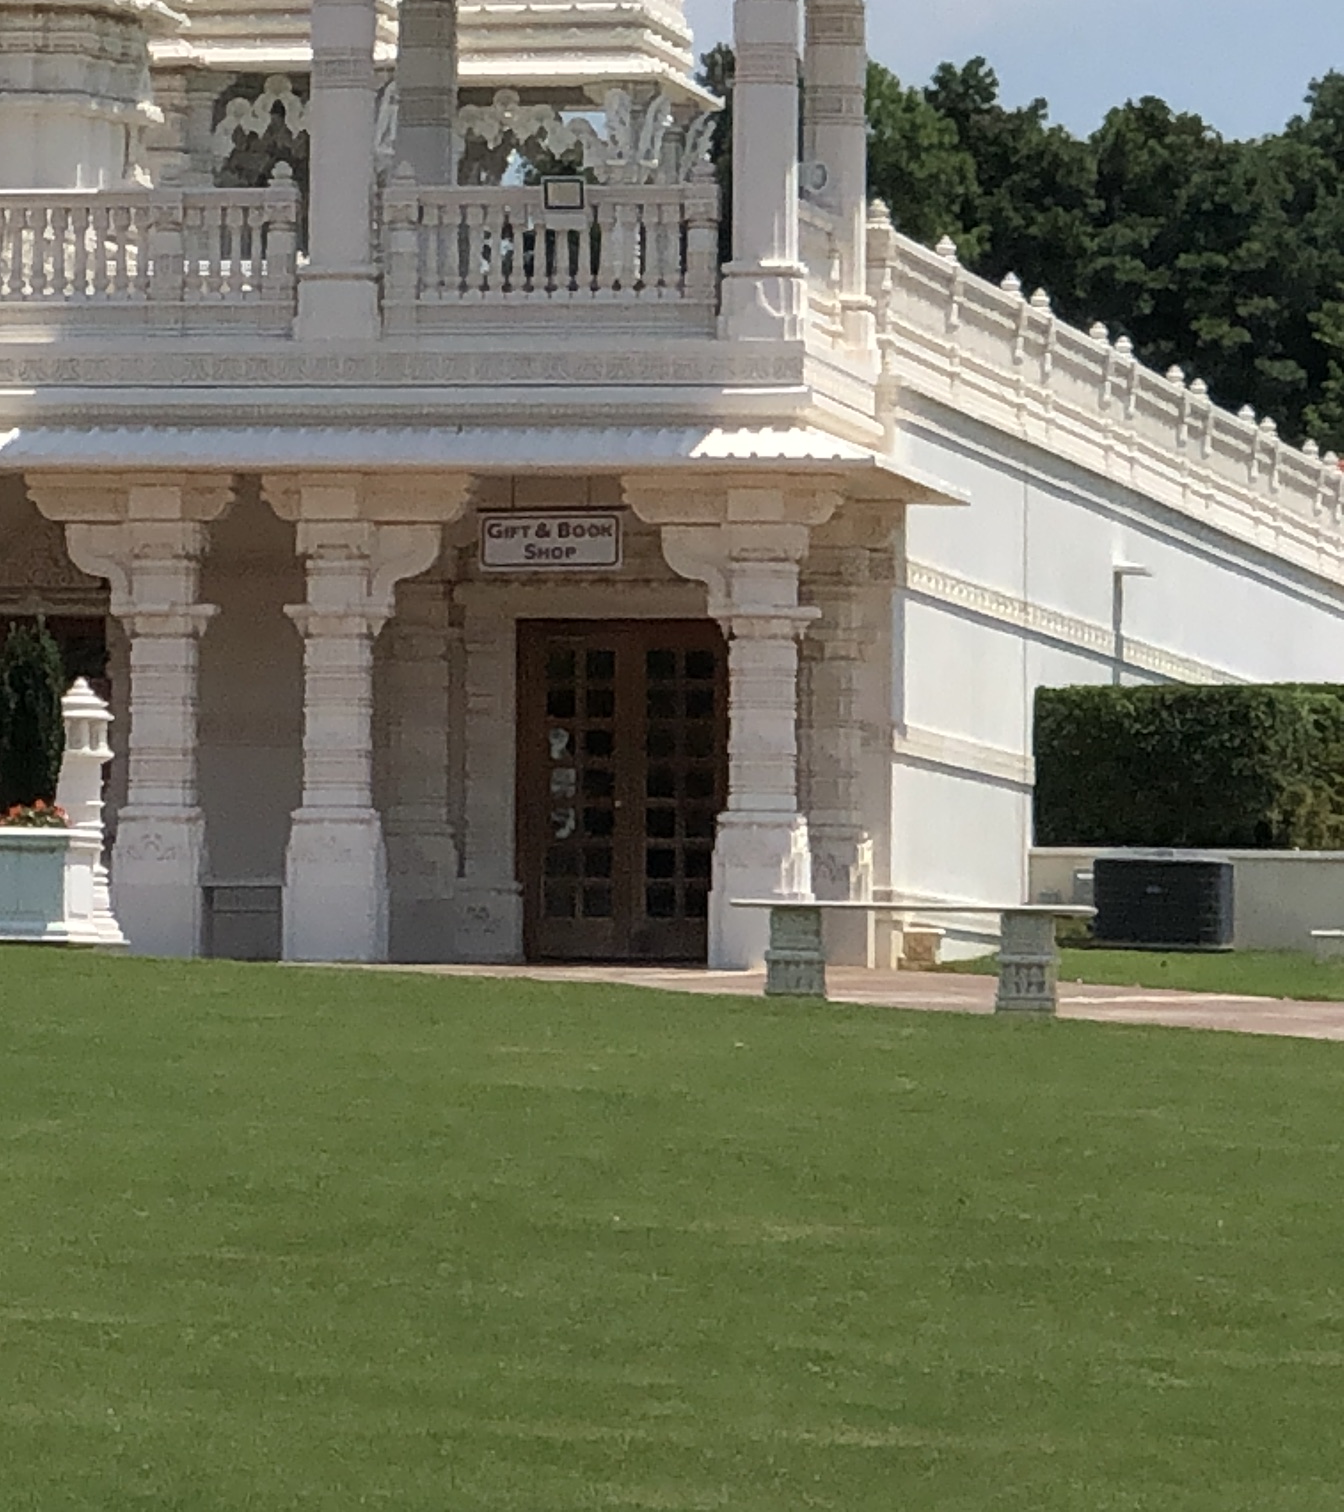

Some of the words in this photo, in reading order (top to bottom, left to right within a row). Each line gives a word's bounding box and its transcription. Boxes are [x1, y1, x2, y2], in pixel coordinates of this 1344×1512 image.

[487, 522, 531, 539] GIFT
[535, 522, 551, 539] &
[557, 521, 612, 539] BOOK
[524, 543, 577, 560] SHOP
